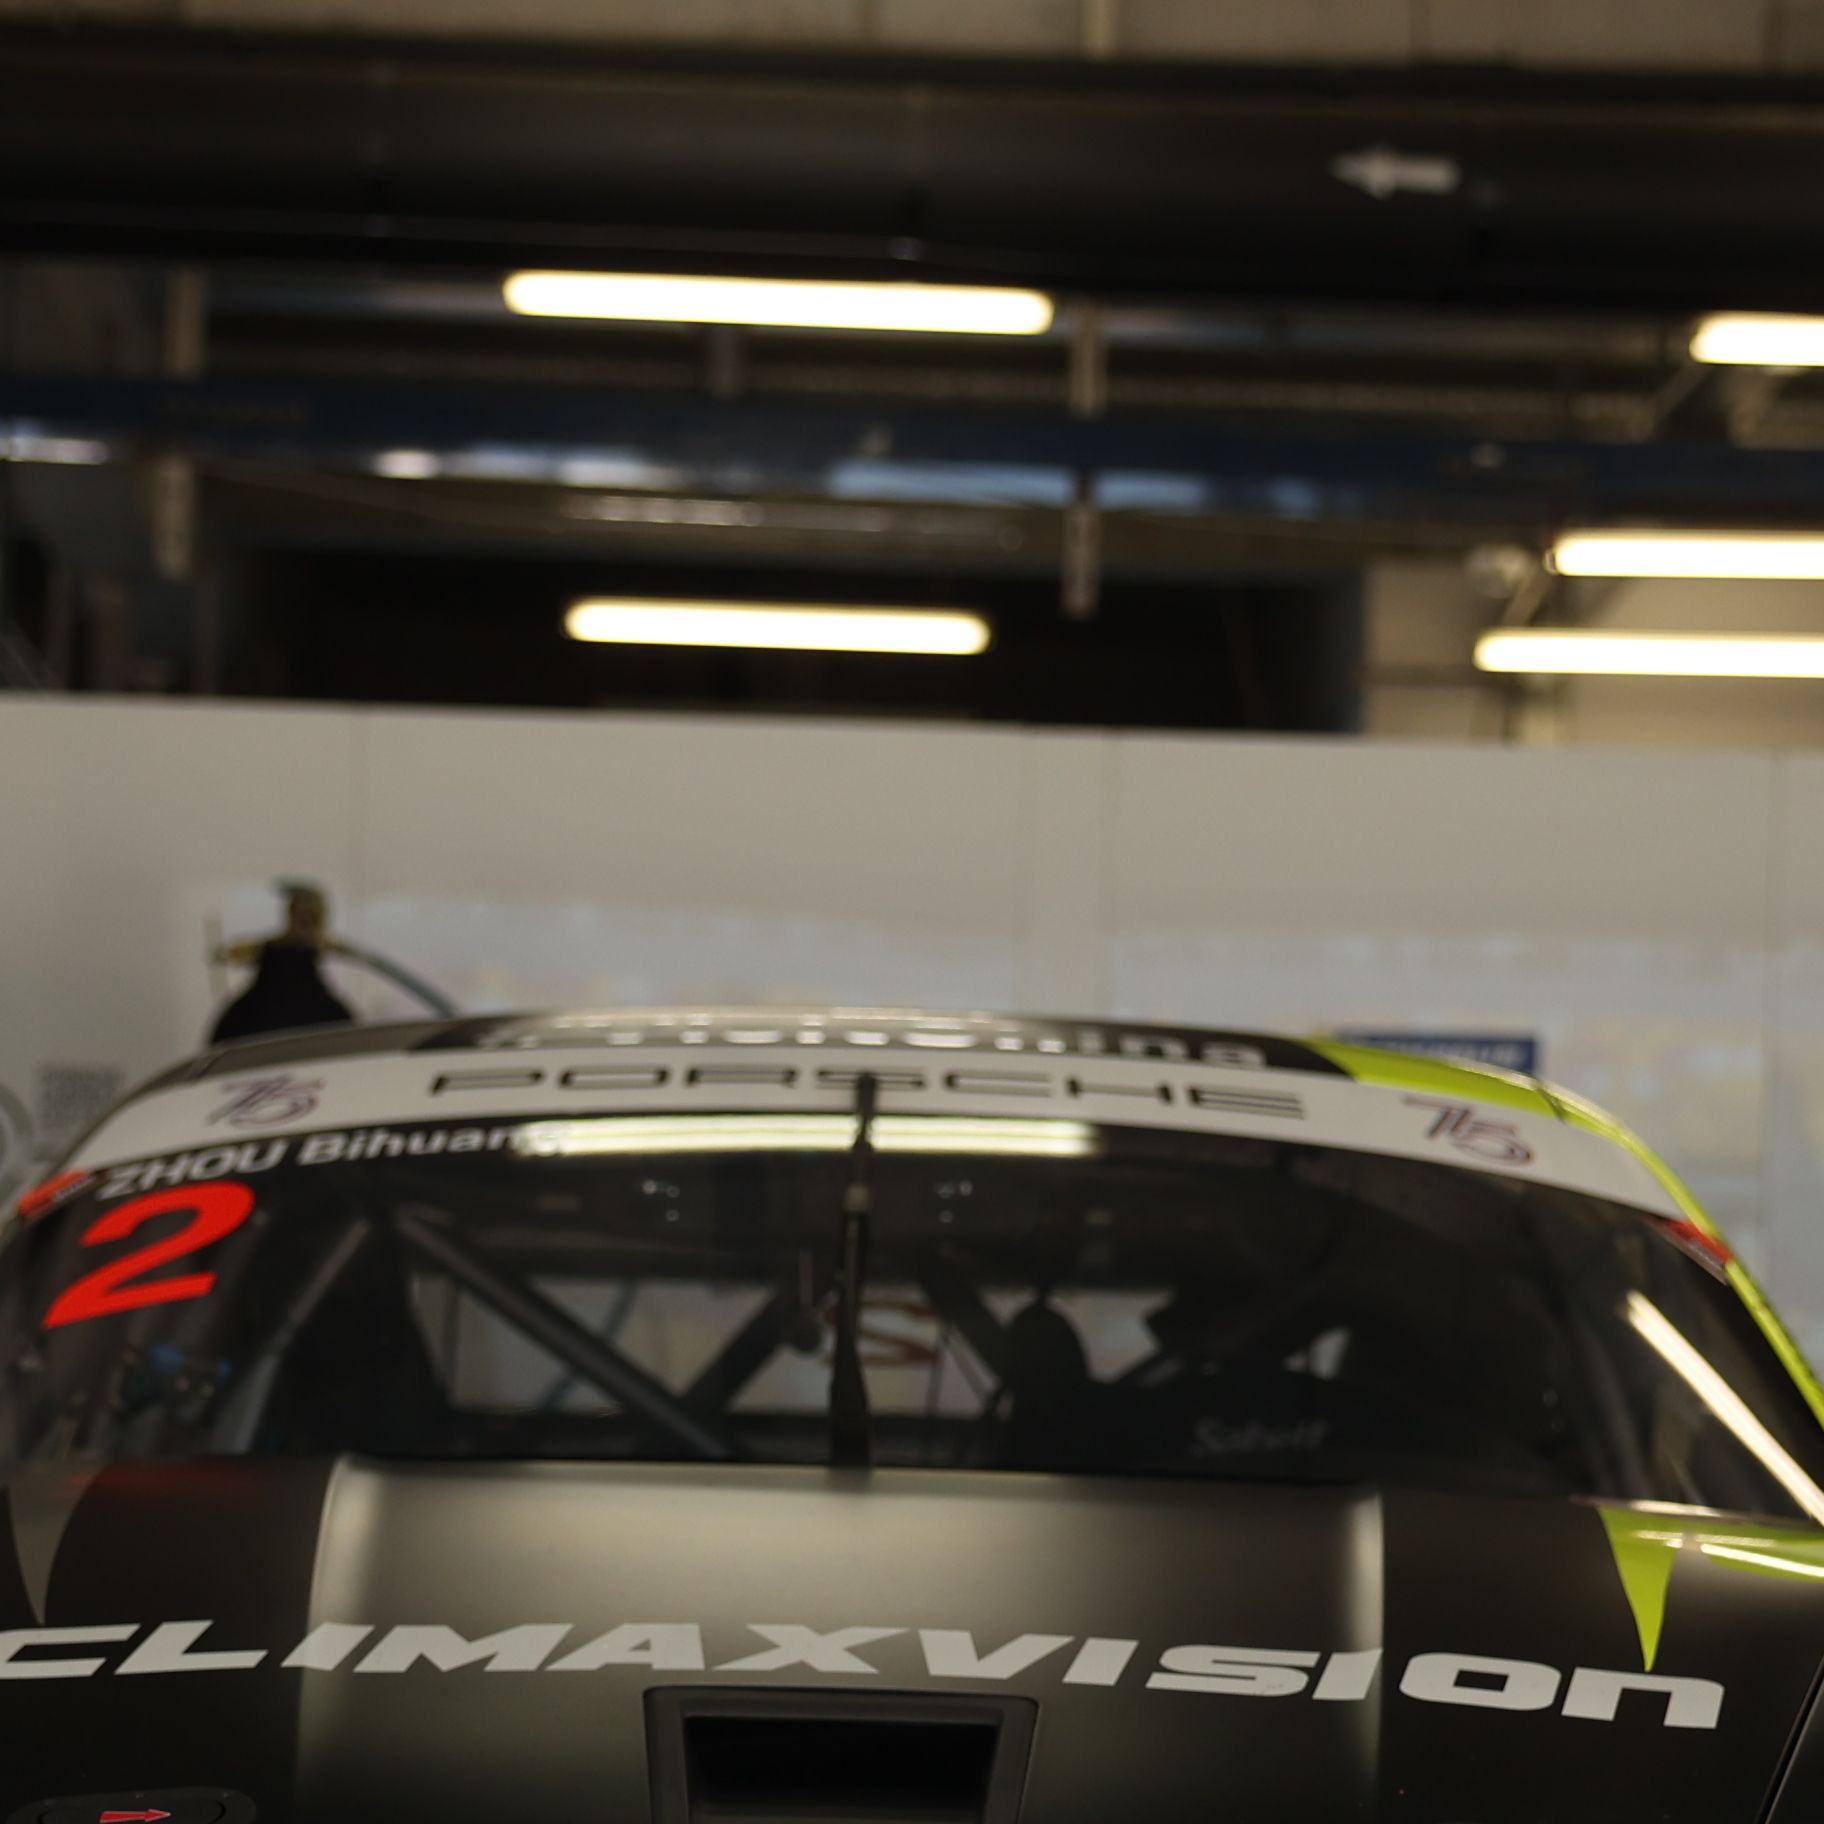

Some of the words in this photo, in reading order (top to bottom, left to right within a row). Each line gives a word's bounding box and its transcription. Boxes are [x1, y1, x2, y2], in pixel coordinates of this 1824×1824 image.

[430, 1062, 1305, 1118] PORSCHE
[97, 1138, 285, 1200] ZHOU
[42, 1179, 256, 1329] 2
